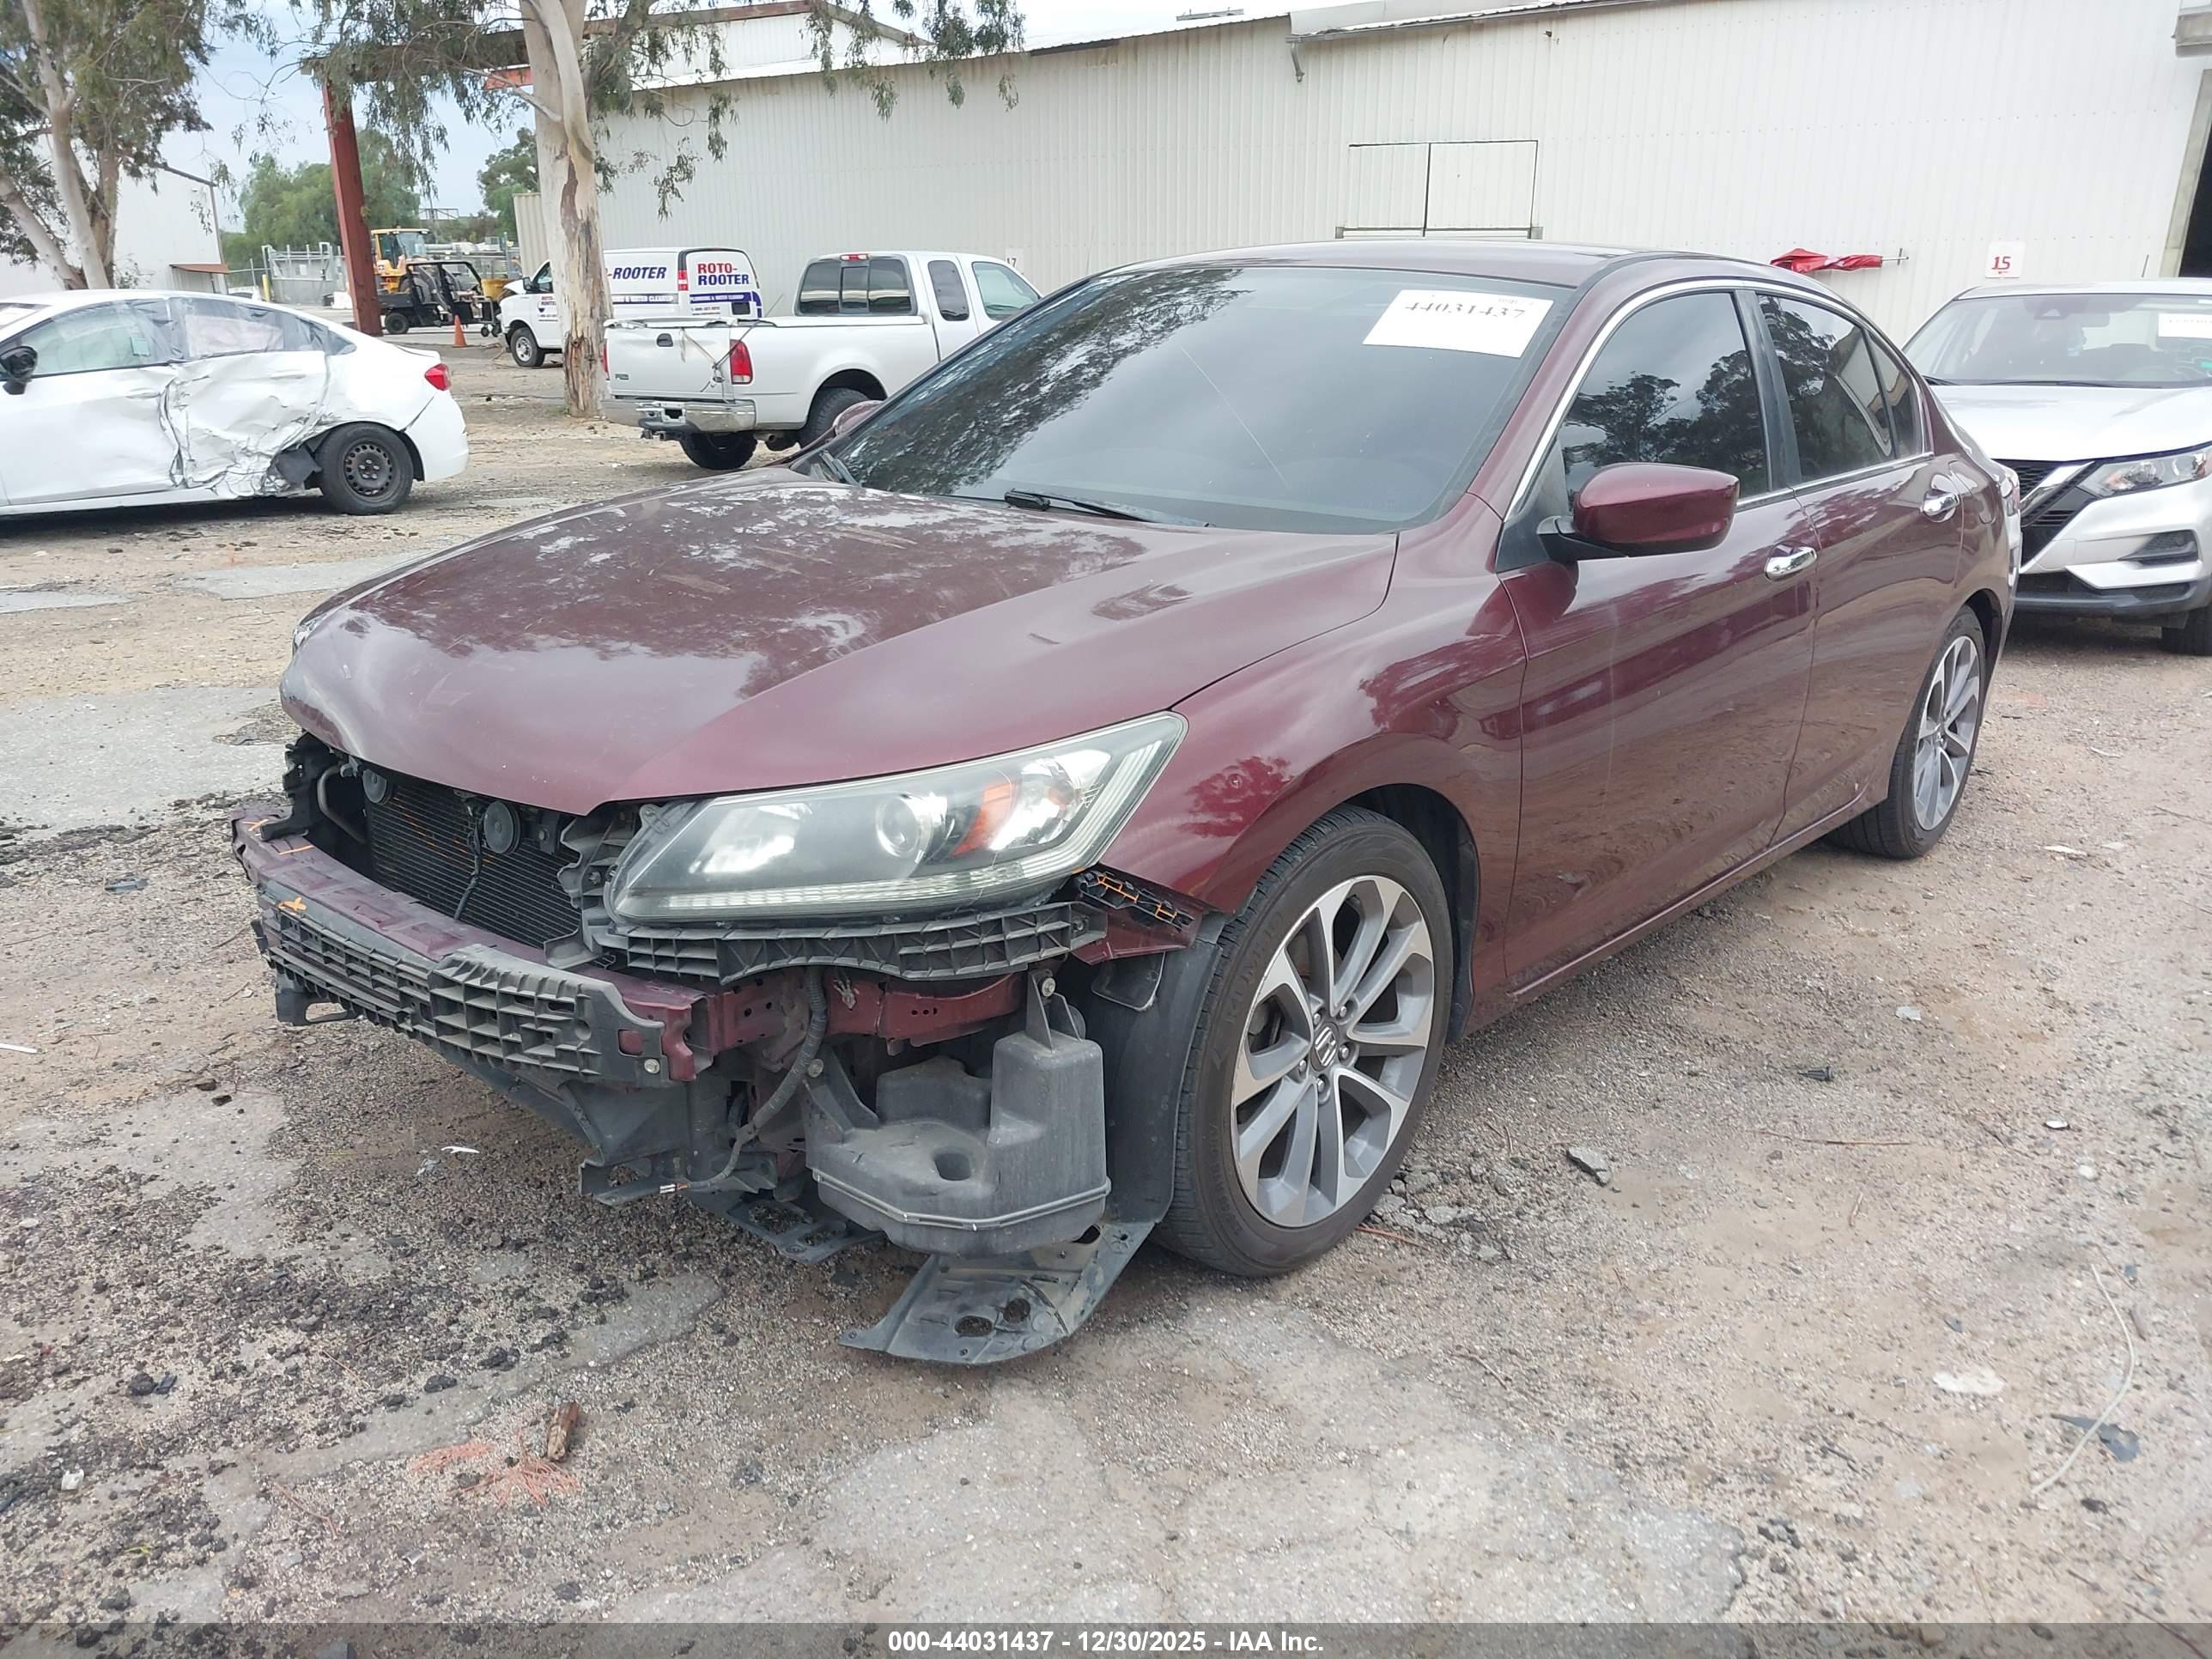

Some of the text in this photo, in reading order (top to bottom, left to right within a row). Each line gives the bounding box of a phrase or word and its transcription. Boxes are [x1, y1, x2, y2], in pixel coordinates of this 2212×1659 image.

[697, 263, 738, 274] ROTO-
[1990, 256, 2012, 270] 15
[606, 267, 667, 280] -ROOTER
[697, 274, 750, 286] ROOTER
[1404, 301, 1526, 319] 44031437
